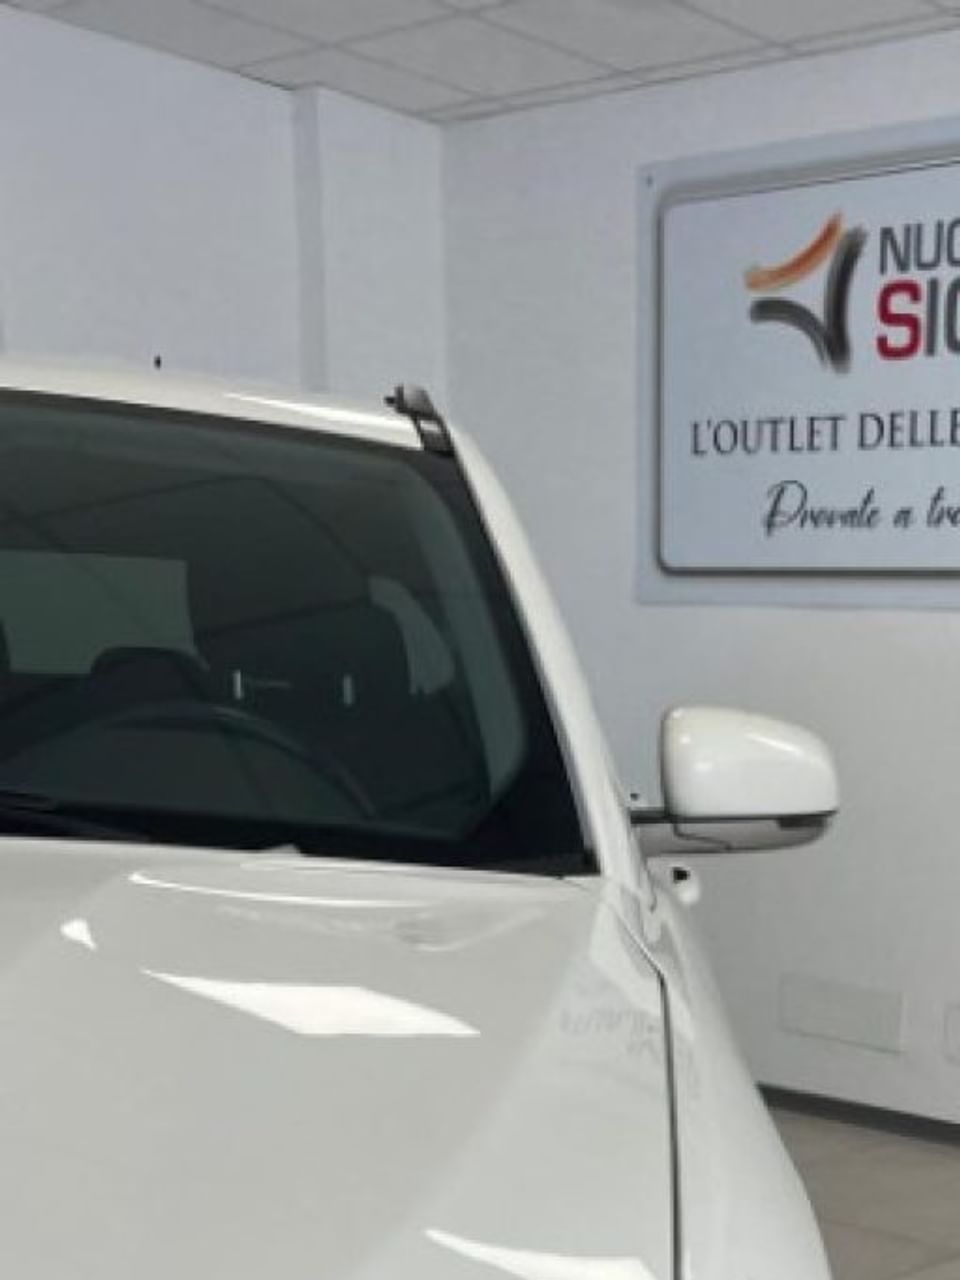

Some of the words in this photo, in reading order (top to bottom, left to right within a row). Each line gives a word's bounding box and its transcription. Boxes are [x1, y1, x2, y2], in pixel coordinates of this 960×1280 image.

[691, 414, 846, 456] L'OUTLET
[763, 479, 881, 538] Provate
[892, 502, 914, 529] a
